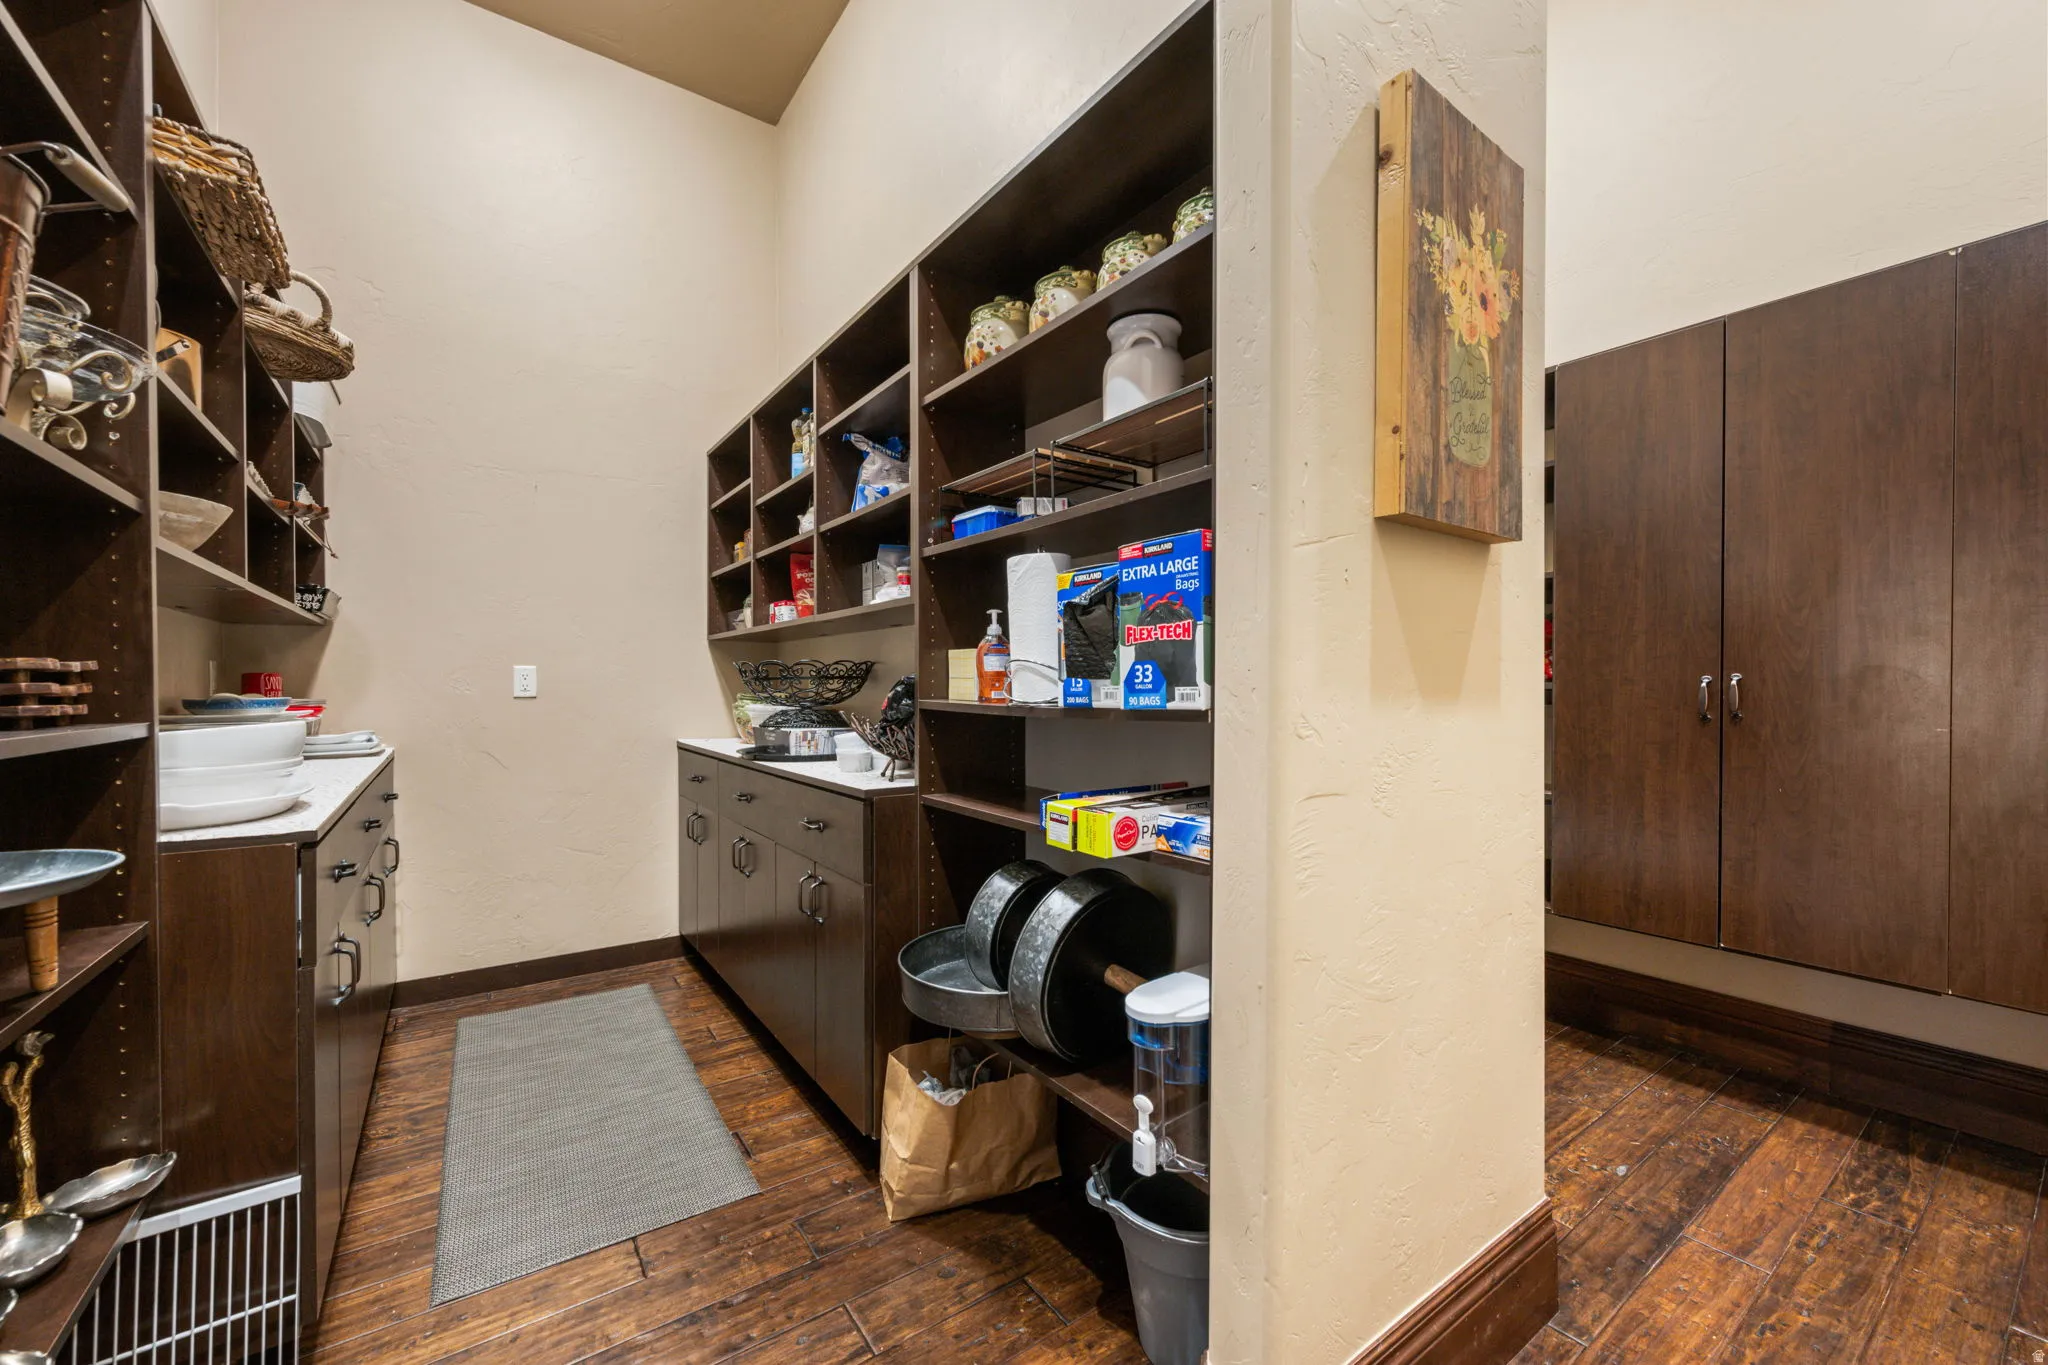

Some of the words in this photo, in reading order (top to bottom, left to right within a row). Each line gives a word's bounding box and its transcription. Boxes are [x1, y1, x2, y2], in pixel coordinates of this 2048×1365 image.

[1449, 374, 1490, 403] Blessed
[1452, 411, 1491, 446] Grateful
[1143, 542, 1173, 554] KIRKLAND
[1074, 571, 1102, 583] KIRKLAND
[1122, 563, 1158, 582] EXTRA
[1160, 556, 1199, 576] LARGE
[1175, 578, 1200, 592] Bags
[1125, 619, 1193, 646] FLEX-TECH
[1134, 664, 1153, 683] 33
[1128, 696, 1138, 706] 90
[1139, 695, 1161, 706] BAGS
